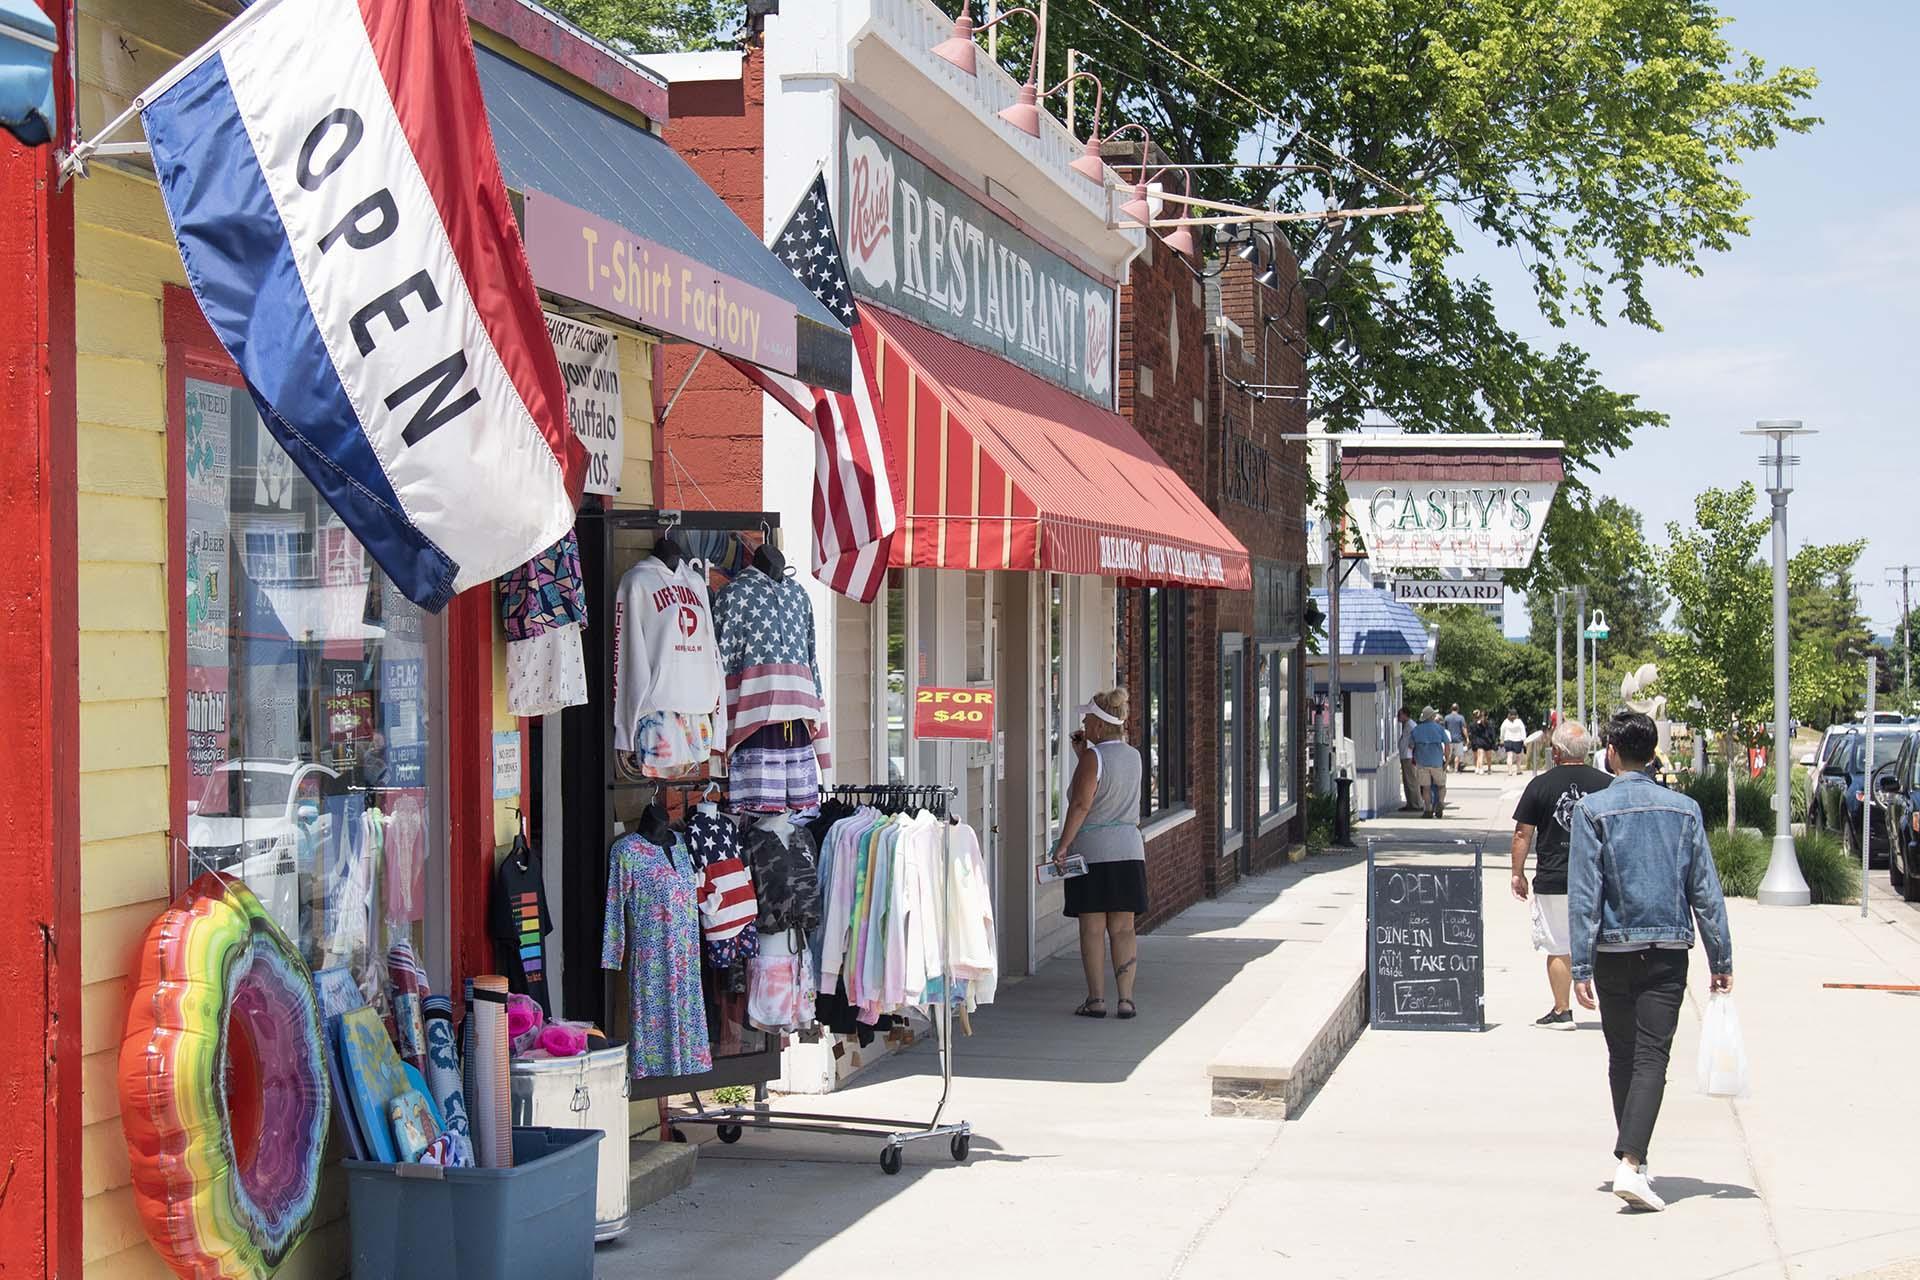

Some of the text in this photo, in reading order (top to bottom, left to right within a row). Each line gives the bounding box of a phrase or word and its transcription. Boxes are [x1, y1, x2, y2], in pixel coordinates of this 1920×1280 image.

[850, 154, 891, 263] Rosie's
[295, 106, 481, 448] OPEN
[899, 178, 1080, 374] RESTAURANT
[582, 226, 760, 361] T-Shirt Factory
[545, 315, 609, 357] HIRT FACTORY
[559, 360, 618, 394] your own
[569, 397, 616, 441] Buffalo
[1369, 486, 1532, 531] CASEY'S
[1100, 536, 1142, 571] BREAKFAST
[1400, 585, 1499, 600] BACKYARD
[396, 664, 418, 687] FLAG
[933, 709, 984, 723] $40
[1388, 873, 1449, 904] OPEN
[1376, 926, 1433, 947] DINE IN
[1378, 949, 1402, 967] ATM
[1409, 955, 1479, 972] TAKE OUT
